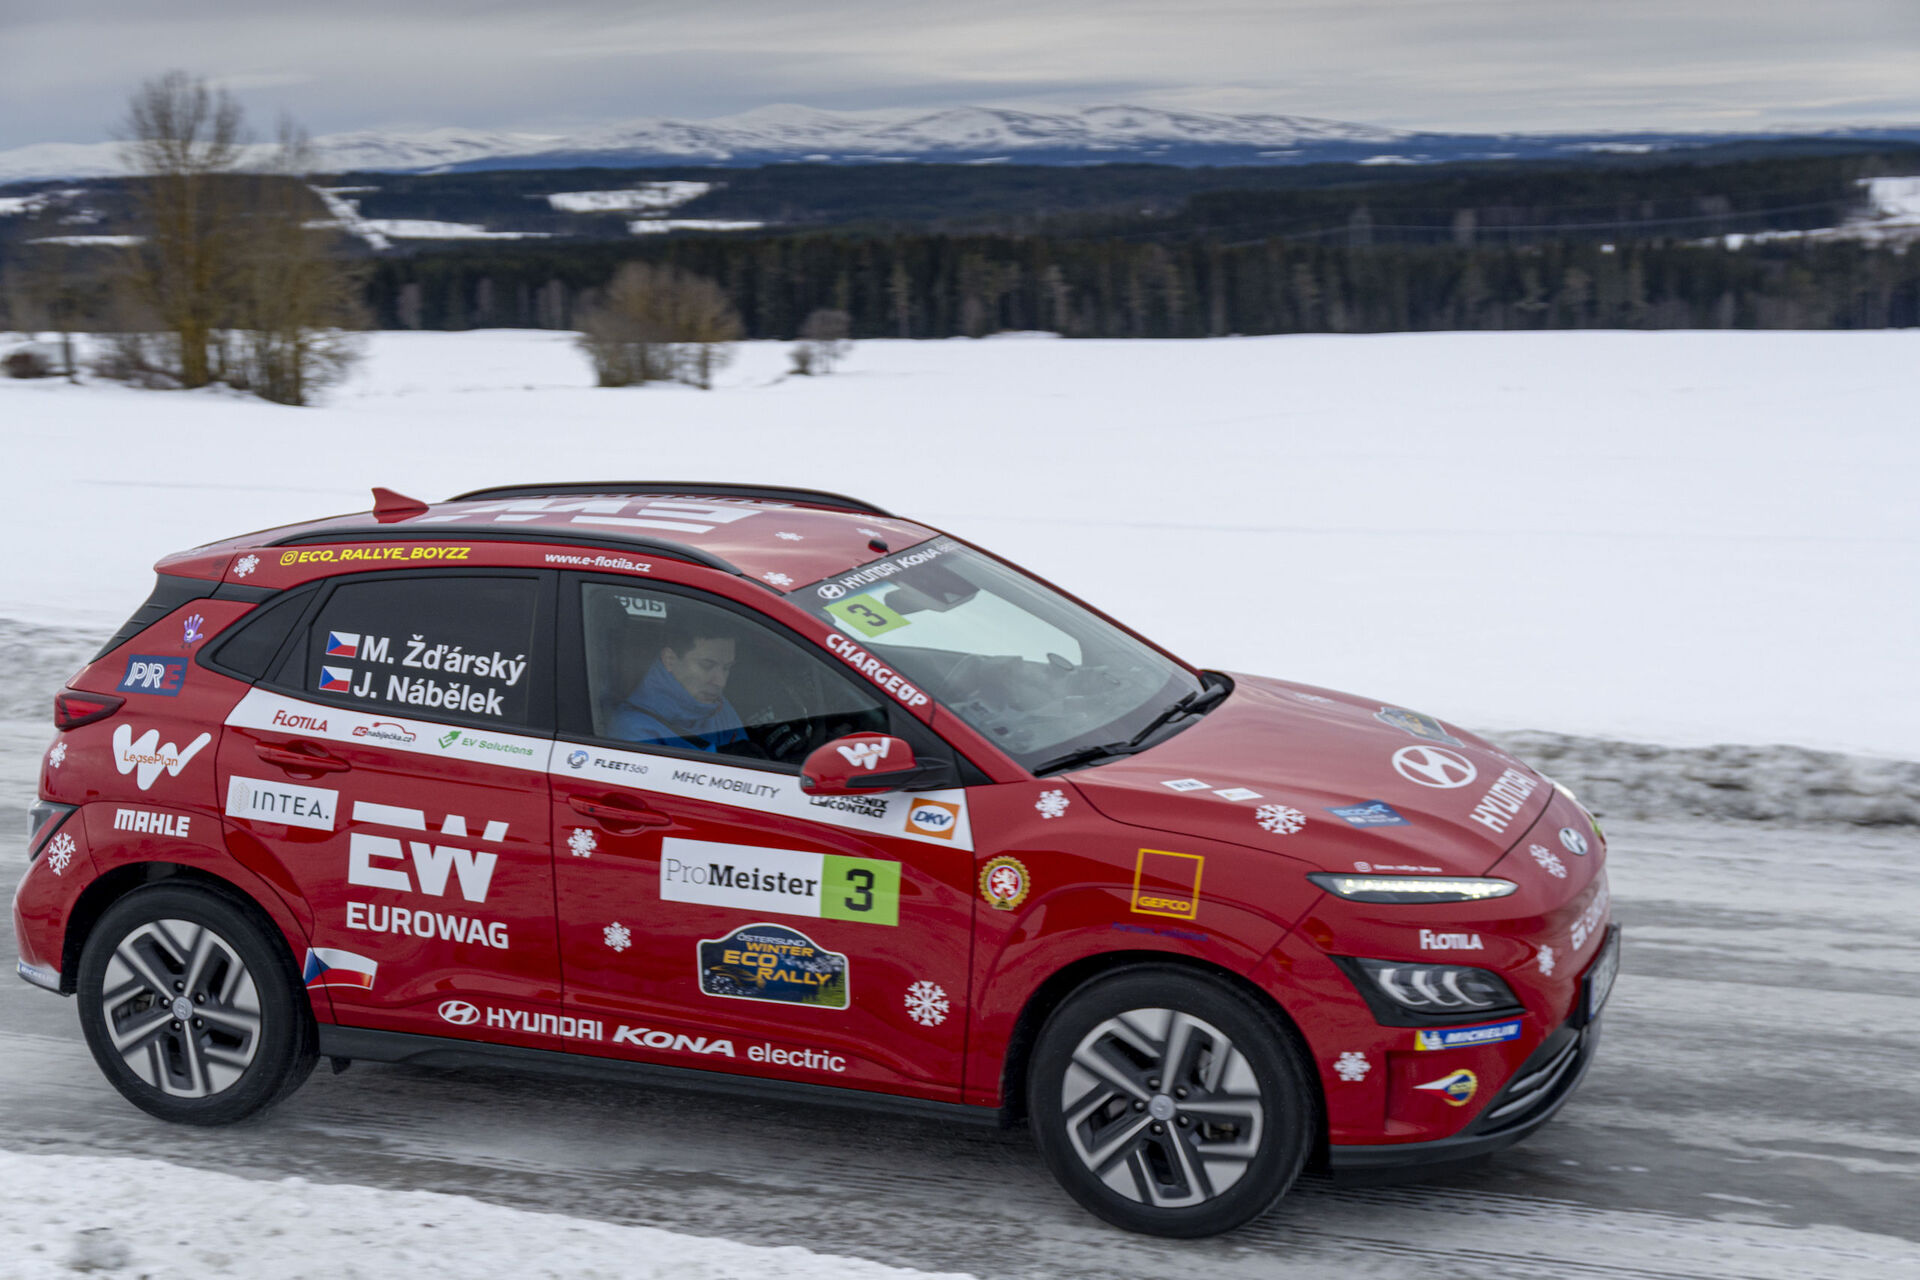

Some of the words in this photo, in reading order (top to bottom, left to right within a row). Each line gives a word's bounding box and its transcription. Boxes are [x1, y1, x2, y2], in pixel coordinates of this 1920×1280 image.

[298, 547, 471, 563] ECO_RALLYE_BOYZZ
[545, 554, 651, 572] www.e-flotila.cz
[839, 561, 900, 590] HYUNDAI
[896, 548, 941, 569] KONA
[847, 604, 887, 627] 3
[361, 635, 394, 664] M.
[402, 634, 526, 686] Žďárský
[124, 662, 182, 689] PRE
[353, 672, 377, 698] J.
[387, 675, 504, 716] Nábělek
[461, 737, 478, 748] EV
[478, 739, 534, 756] Solutions
[123, 750, 178, 767] LeasePlan
[594, 758, 648, 774] FLEET360
[672, 770, 707, 786] MHC
[708, 777, 780, 799] MOBILITY
[829, 800, 887, 818] CONTACT
[1469, 768, 1538, 833] HYUNDAI
[113, 808, 191, 838] MAHLE
[914, 811, 953, 826] DKV
[666, 858, 818, 897] ProMeister
[844, 868, 875, 912] 3
[1138, 896, 1191, 912] GEFCO
[346, 901, 509, 949] EUROWAG
[736, 931, 806, 947] ÖSTERSUND
[746, 942, 815, 957] WINTER
[723, 950, 778, 968] ECO
[756, 967, 832, 985] RALLY
[486, 1006, 602, 1041] HYUNDAI
[613, 1025, 735, 1057] KONA
[747, 1043, 846, 1073] electric
